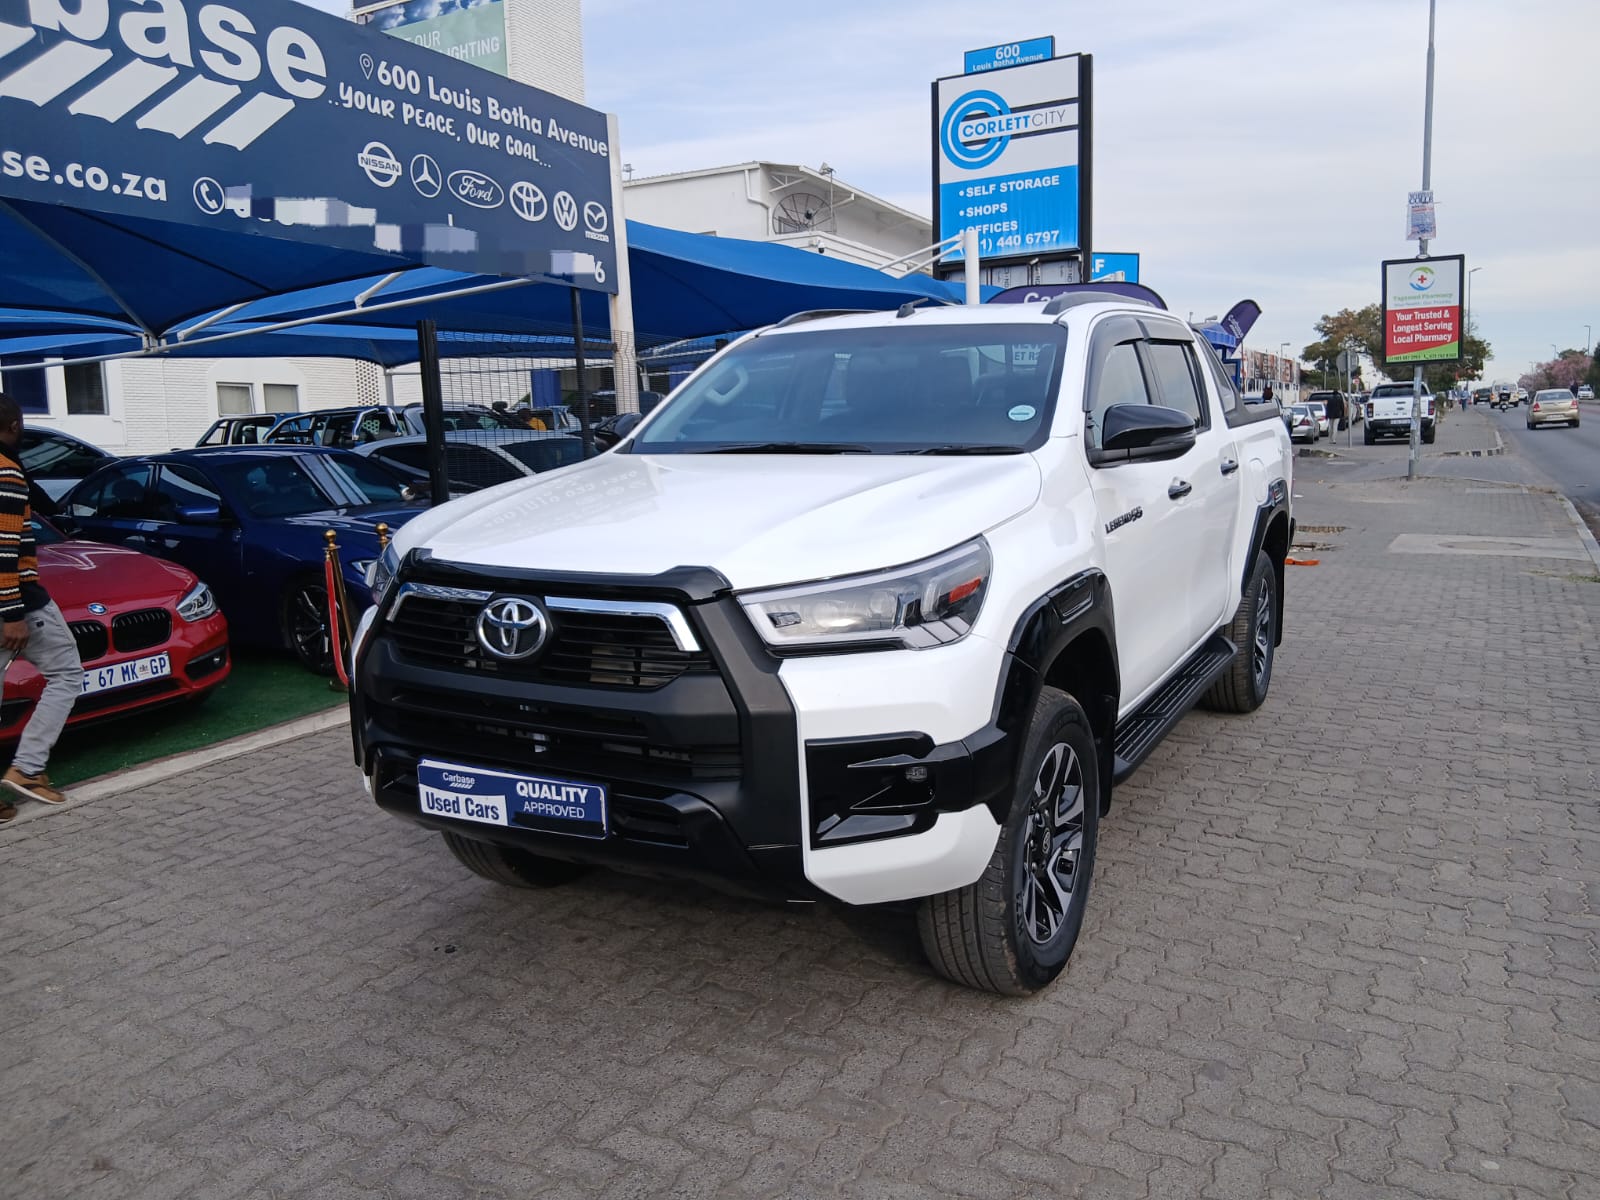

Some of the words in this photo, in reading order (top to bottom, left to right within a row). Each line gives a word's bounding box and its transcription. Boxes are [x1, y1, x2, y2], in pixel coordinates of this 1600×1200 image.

[995, 44, 1020, 60] 600
[973, 62, 992, 72] Louis
[993, 58, 1015, 68] Botha
[1015, 53, 1044, 65] Avenue
[378, 61, 420, 95] 600
[428, 76, 481, 115] Louis
[487, 97, 542, 135] Botha
[548, 119, 608, 158] Avenue
[402, 102, 460, 141] PEACE,
[467, 123, 499, 149] OUR
[360, 157, 400, 173] NISSAN
[0, 150, 167, 201] se.co.za
[459, 175, 494, 202] Ford
[966, 184, 996, 198] SELF
[1000, 175, 1060, 192] STORAGE
[966, 203, 1008, 217] SHOPS
[996, 234, 1021, 248] 440
[1025, 230, 1060, 244] 6797
[1396, 312, 1412, 321] Your
[1414, 310, 1442, 320] Trusted
[1443, 309, 1450, 318] &
[1393, 323, 1422, 333] Longest
[1424, 321, 1453, 331] Serving
[1393, 334, 1413, 344] Local
[1414, 333, 1453, 343] Pharmacy
[98, 668, 114, 688] 67
[121, 662, 138, 682] MK
[150, 657, 166, 675] GP
[442, 772, 475, 785] Carbase
[516, 781, 588, 803] QUALITY
[426, 791, 461, 815] Used
[465, 798, 499, 820] Cars
[523, 801, 585, 819] APPROVED
